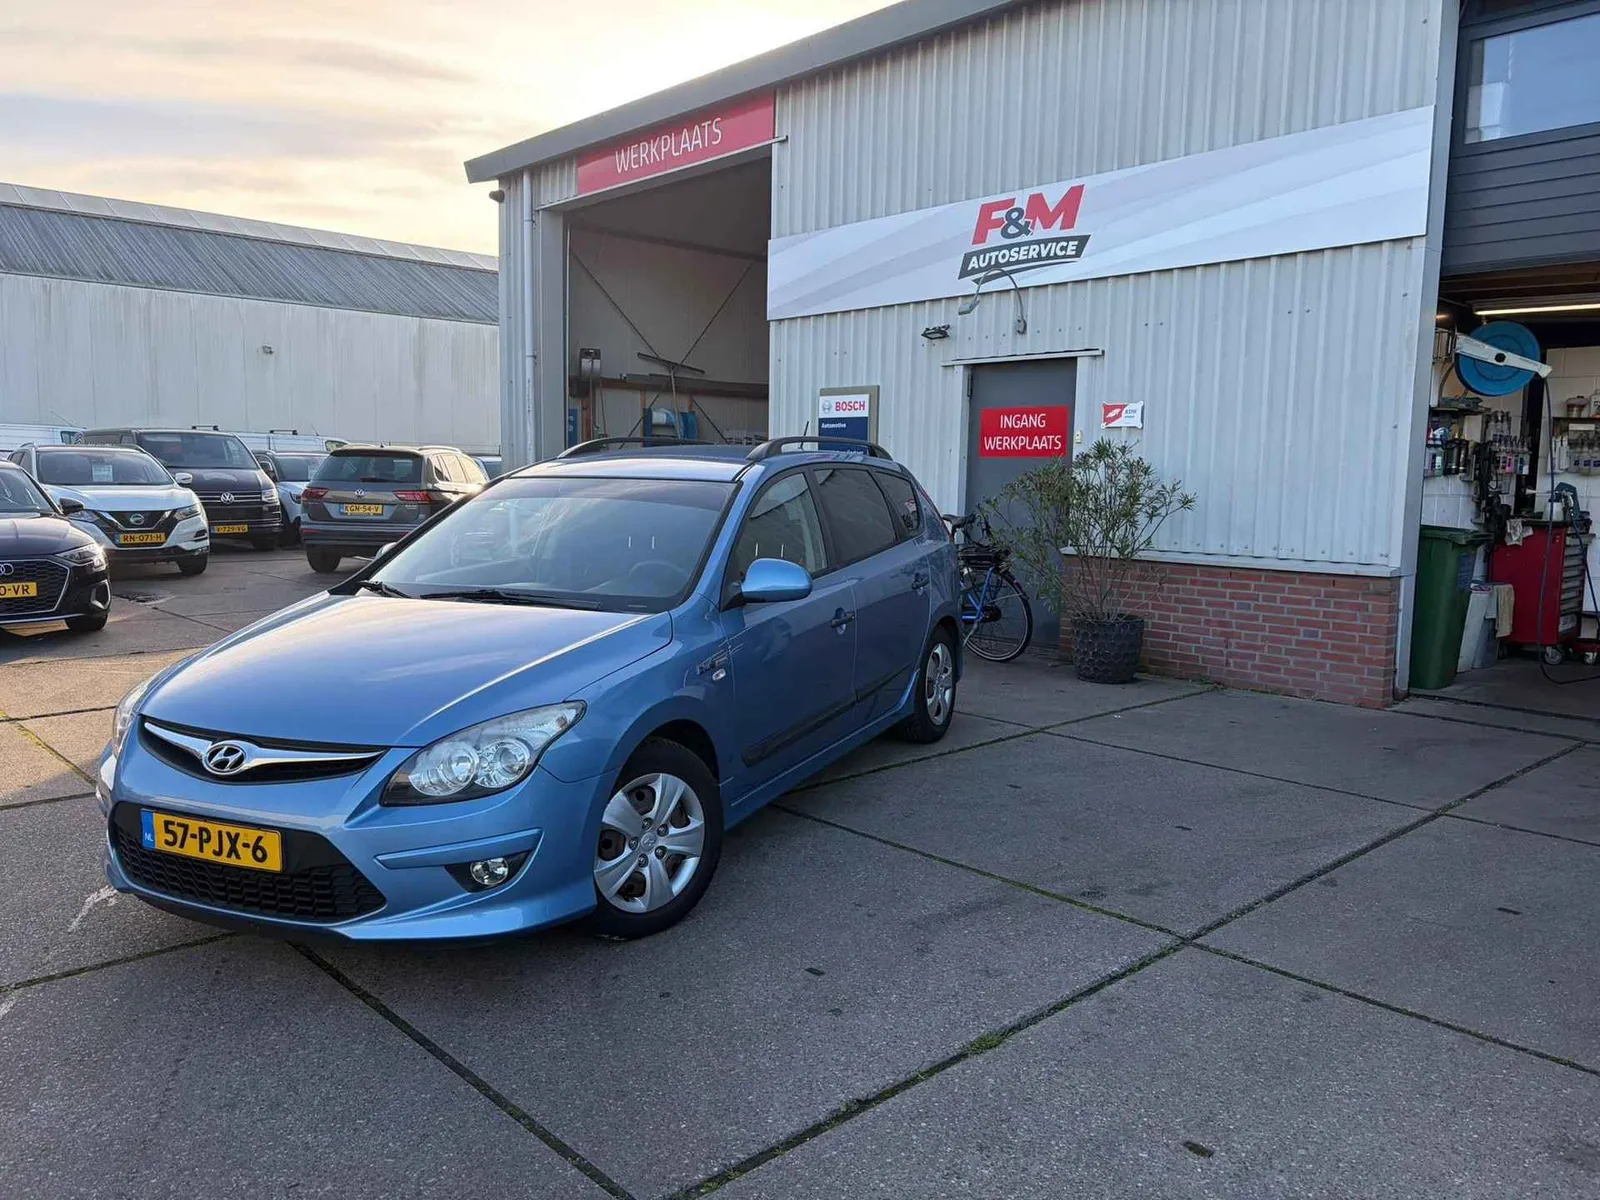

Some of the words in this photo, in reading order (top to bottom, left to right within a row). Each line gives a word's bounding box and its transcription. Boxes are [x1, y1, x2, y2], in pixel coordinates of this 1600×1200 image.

[615, 117, 722, 174] WERKPLAATS
[972, 184, 1084, 245] F&M
[967, 241, 1078, 271] AUTOSERVICE
[835, 401, 866, 411] BOSCH
[1000, 413, 1046, 429] INGANG
[984, 435, 1062, 450] WERKPLAATS
[345, 504, 379, 512] KGN-54-V
[123, 533, 162, 542] RN-071-H
[144, 833, 154, 842] NL
[163, 820, 267, 863] 57-PJX-6
